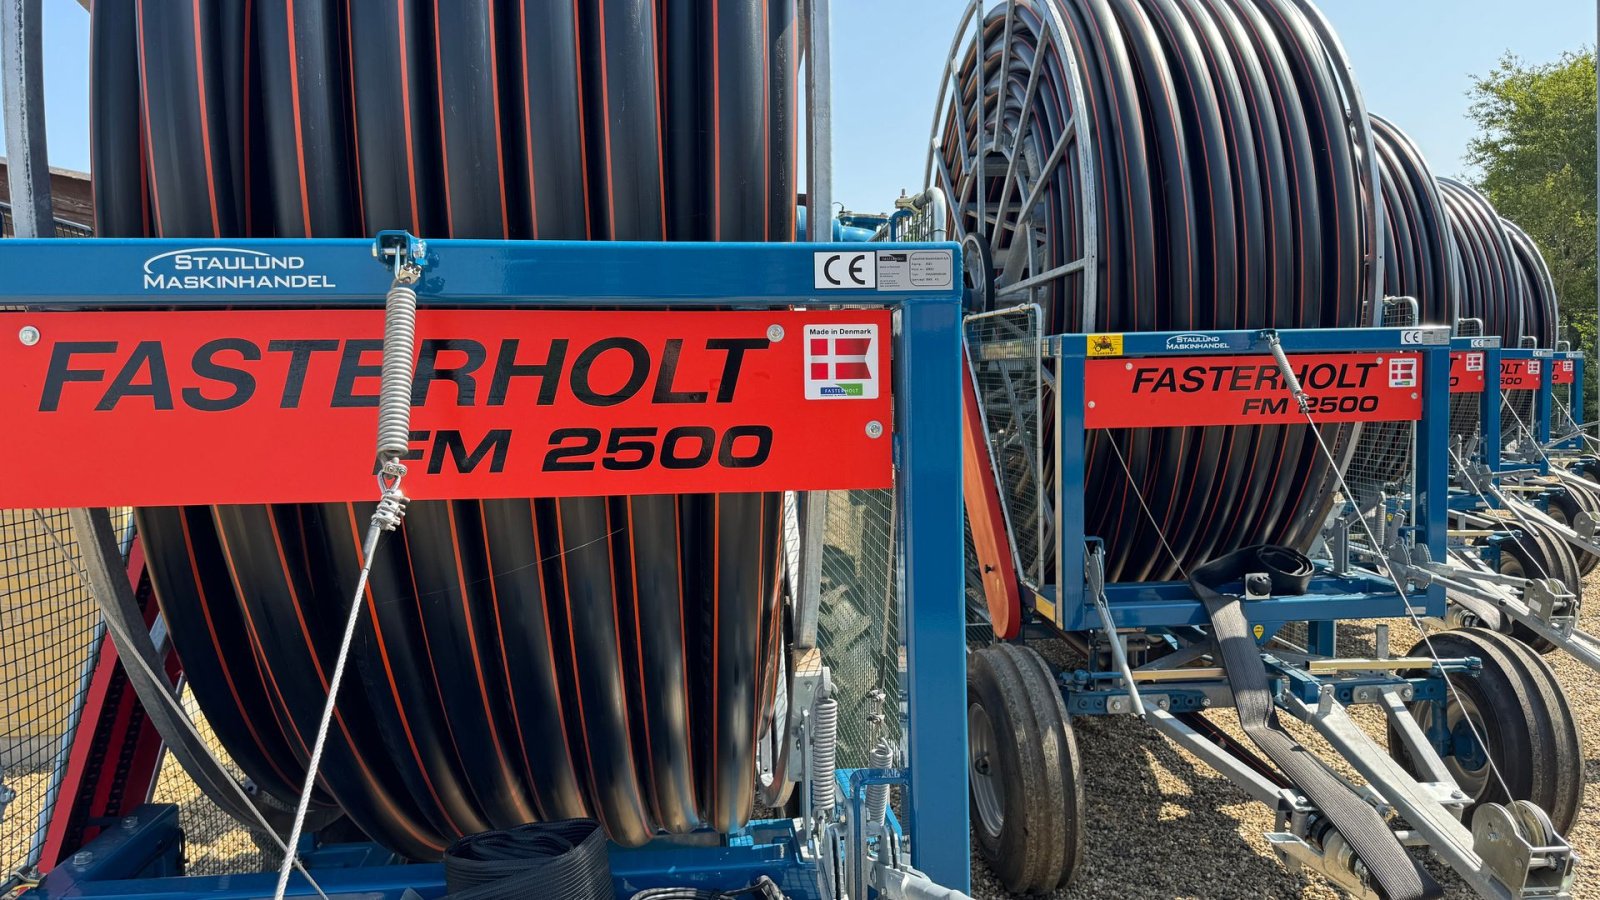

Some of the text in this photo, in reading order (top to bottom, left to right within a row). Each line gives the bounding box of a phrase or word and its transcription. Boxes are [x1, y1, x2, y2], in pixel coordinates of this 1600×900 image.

[175, 254, 304, 270] STAULUND
[823, 254, 866, 286] CE
[143, 274, 336, 289] MASKINHANDEL
[1166, 342, 1230, 350] MASKINHANDEL
[1404, 331, 1420, 343] CE
[38, 336, 771, 412] FASTERHOLT
[1132, 362, 1379, 394] FASTERHOLT
[1242, 395, 1379, 415] FM 2500
[541, 424, 773, 473] 2500
